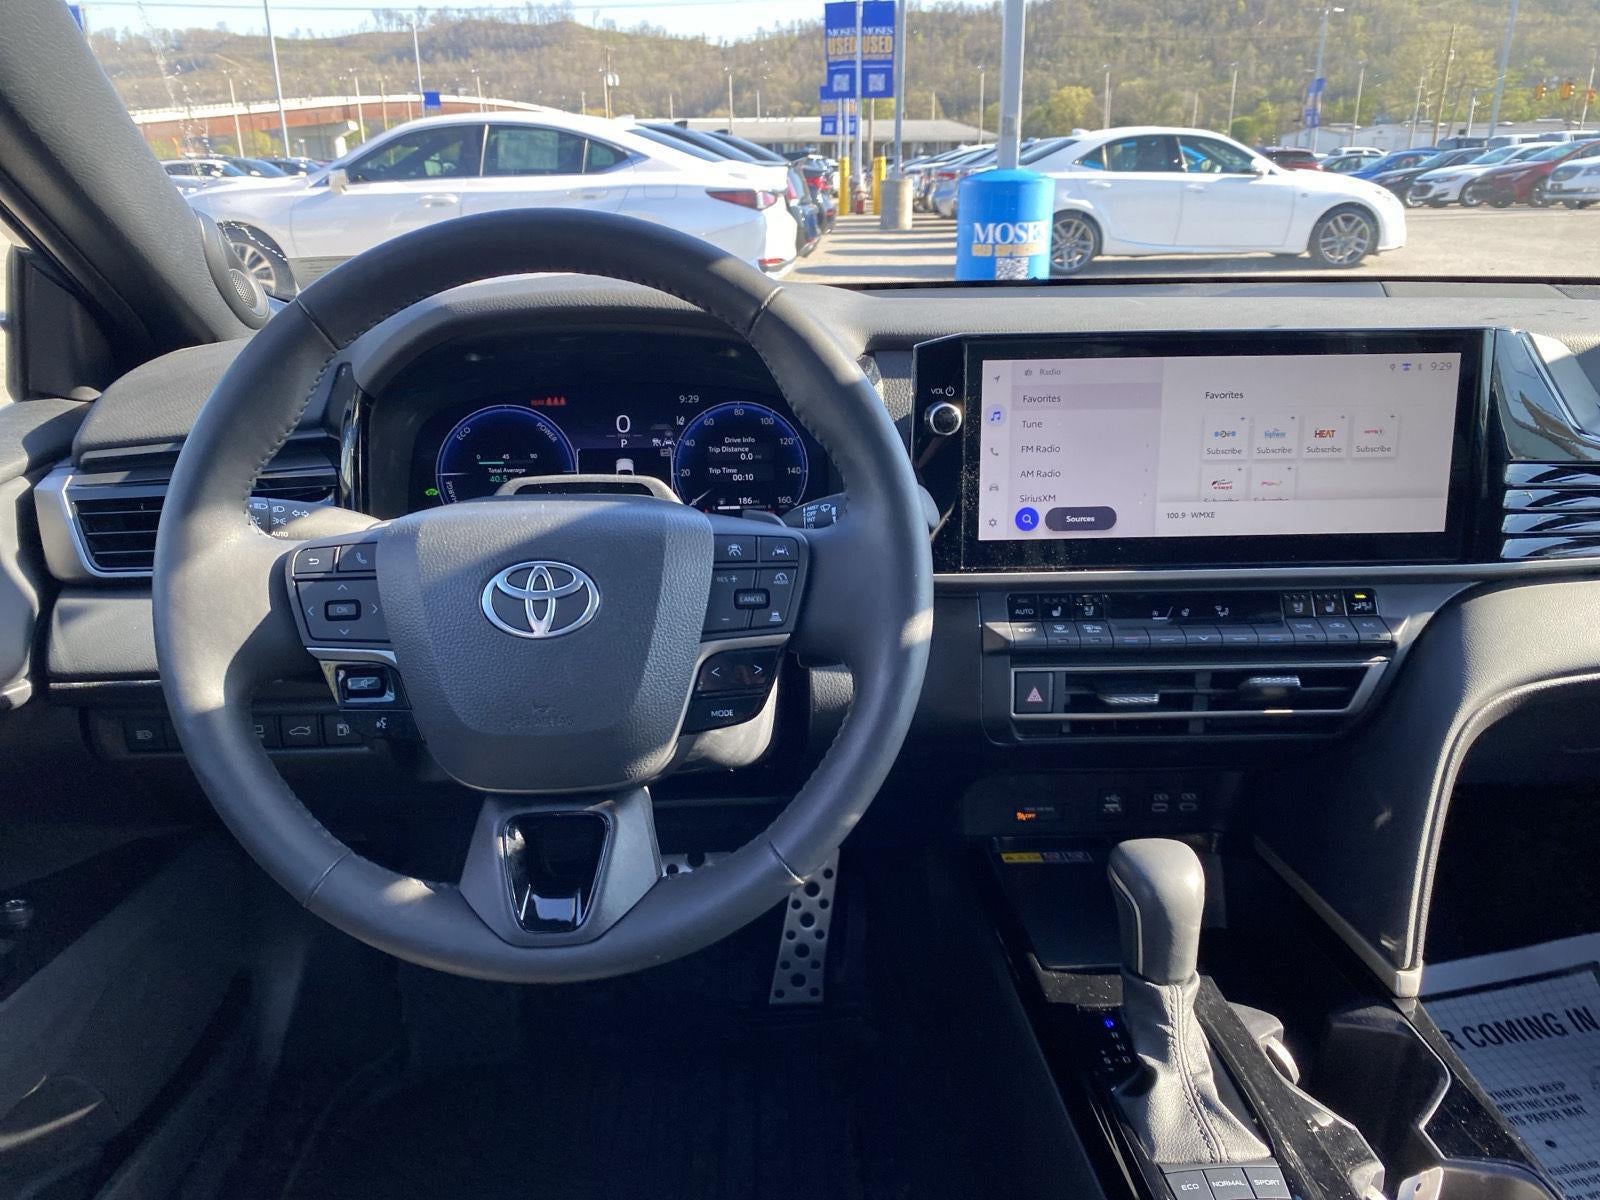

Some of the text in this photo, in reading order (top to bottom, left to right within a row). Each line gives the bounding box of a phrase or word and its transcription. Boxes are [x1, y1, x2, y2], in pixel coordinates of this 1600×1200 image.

[862, 26, 893, 35] MOSES
[862, 36, 893, 53] USED
[1430, 362, 1452, 371] 9:29
[1039, 368, 1061, 376] Radio
[679, 395, 699, 403] 9:29
[1022, 394, 1061, 403] Favorites
[1205, 391, 1244, 400] Favorites
[734, 408, 744, 416] 80
[616, 414, 631, 433] 0
[704, 418, 714, 426] 60
[760, 417, 775, 425] 100
[1022, 420, 1043, 429] Tune
[456, 426, 471, 441] ECO
[536, 422, 558, 442] POWER
[1314, 430, 1336, 438] HEAT
[621, 439, 628, 448] P
[684, 440, 695, 448] 40
[724, 436, 756, 444] Drive Info
[779, 437, 793, 446] 120
[1021, 444, 1061, 454] FM Radio
[1206, 447, 1242, 455] Subscribe
[1256, 446, 1293, 455] Subscribe
[1306, 446, 1342, 454] Subscribe
[1355, 445, 1391, 453] Subscribe
[680, 468, 690, 477] 20
[787, 467, 800, 475] 140
[1020, 469, 1061, 478] AM Radio
[489, 475, 507, 483] 40.5
[732, 473, 754, 481] 00:10
[738, 496, 753, 505] 186
[778, 496, 791, 504] 160
[1019, 494, 1056, 503] SiriusXM
[1065, 515, 1095, 524] Sources
[1190, 511, 1216, 519] WMXE
[711, 709, 734, 717] MODE
[1461, 1012, 1569, 1048] COMING
[1565, 1005, 1600, 1033] IN
[1522, 1085, 1541, 1096] TO
[1544, 1093, 1582, 1107] CLEAN
[1525, 1109, 1565, 1125] PAPER
[1561, 1104, 1589, 1119] MAT
